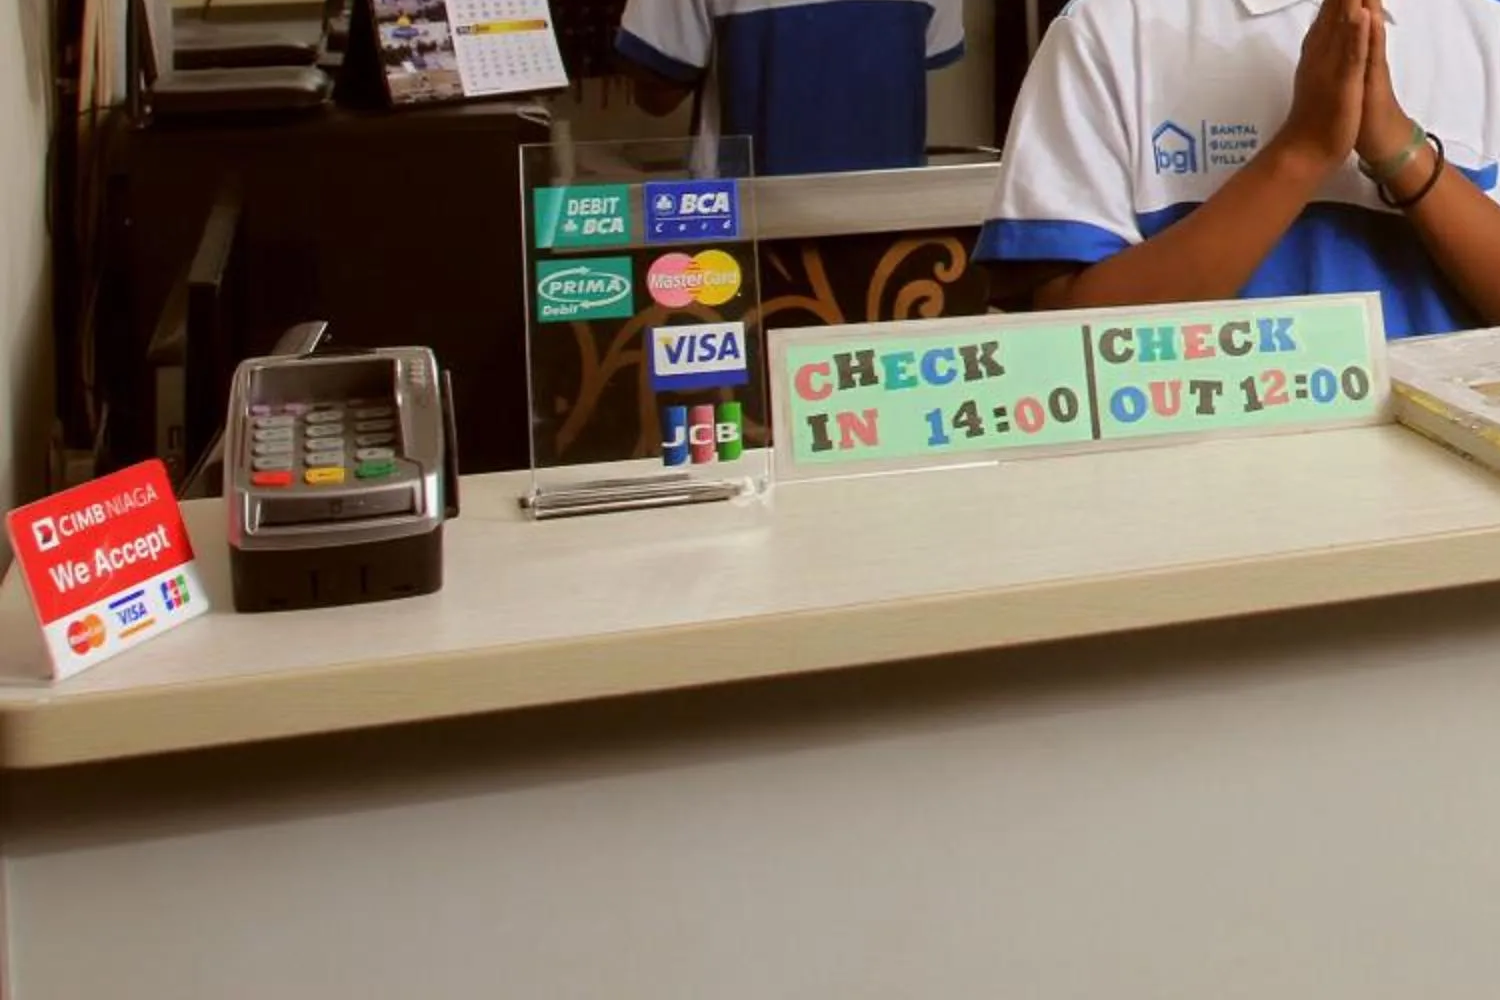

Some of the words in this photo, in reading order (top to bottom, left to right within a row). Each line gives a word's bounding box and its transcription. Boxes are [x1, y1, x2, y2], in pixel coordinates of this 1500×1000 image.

[567, 196, 621, 217] DEBIT
[679, 191, 731, 215] BCA
[582, 217, 625, 236] BCA
[549, 276, 622, 295] PRIMA
[650, 268, 738, 291] MasterCard
[542, 303, 580, 317] Debit
[663, 331, 741, 366] VISA
[1099, 316, 1298, 364] CHECK
[793, 340, 1005, 401] CHECK
[1110, 378, 1223, 424] OUT
[1239, 365, 1370, 413] 12:00
[806, 407, 880, 453] IN
[924, 386, 1079, 446] 14:00
[661, 422, 740, 448] JCB
[59, 503, 106, 537] CIMB
[107, 483, 159, 517] NIAGA
[48, 558, 92, 593] We
[94, 523, 171, 578] Accept
[115, 601, 148, 625] VISA
